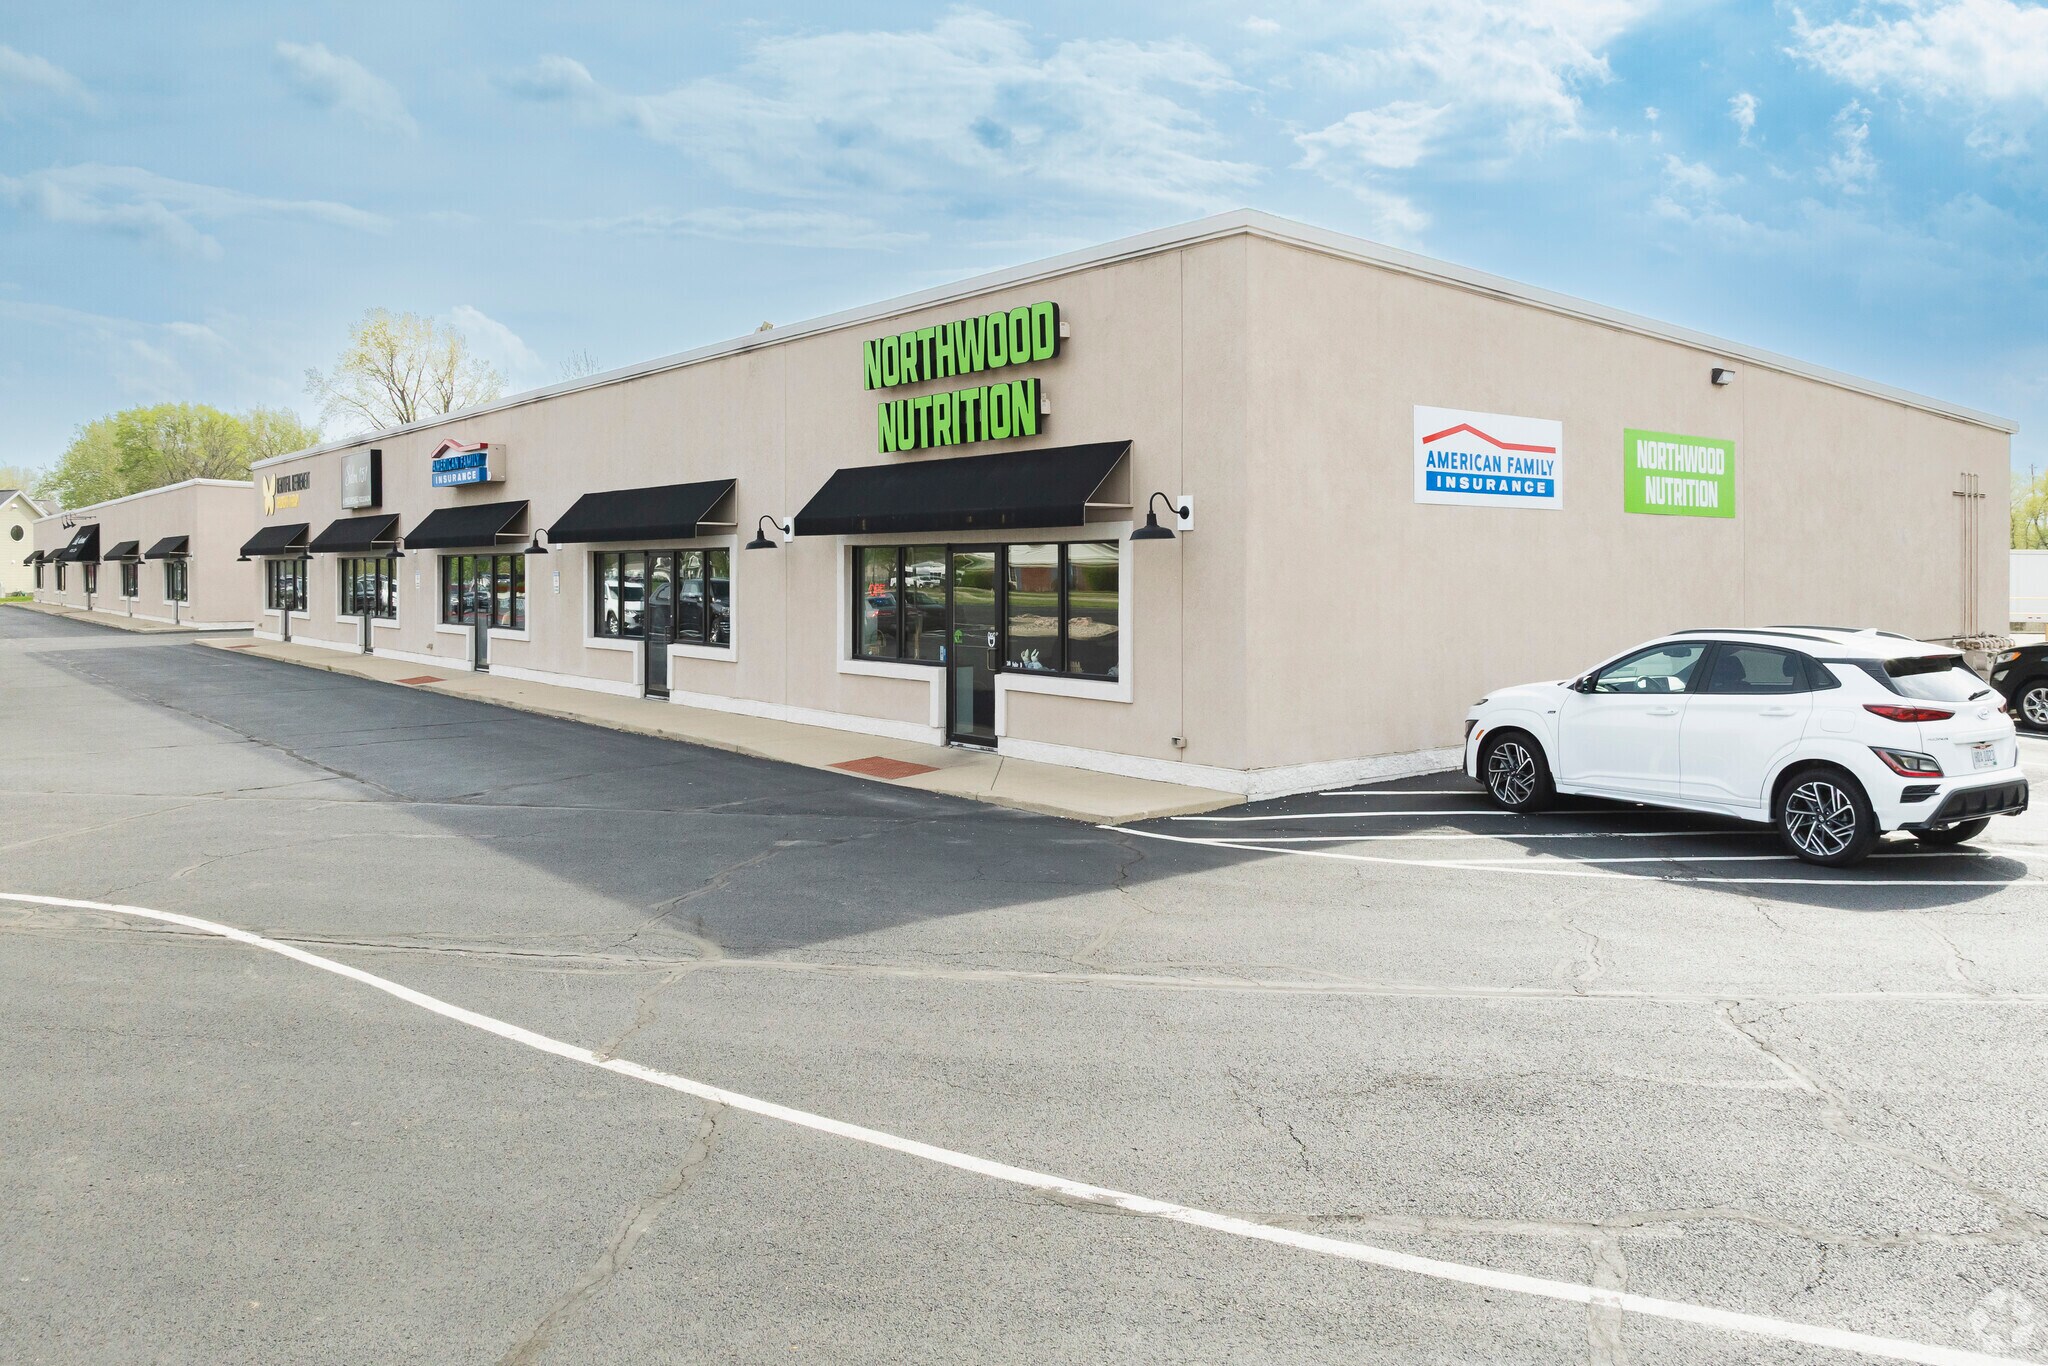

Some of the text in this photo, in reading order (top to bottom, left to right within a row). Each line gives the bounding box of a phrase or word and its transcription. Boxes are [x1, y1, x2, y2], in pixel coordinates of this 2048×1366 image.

[863, 301, 1056, 390] NORTHWOOD
[878, 378, 1038, 453] NUTRITION
[1426, 450, 1554, 476] AMERICAN FAMILY
[1637, 439, 1725, 475] NORTHWOOD
[435, 470, 477, 484] INSURANCE
[1436, 475, 1546, 493] INSURANCE
[1645, 475, 1718, 508] NUTRITION
